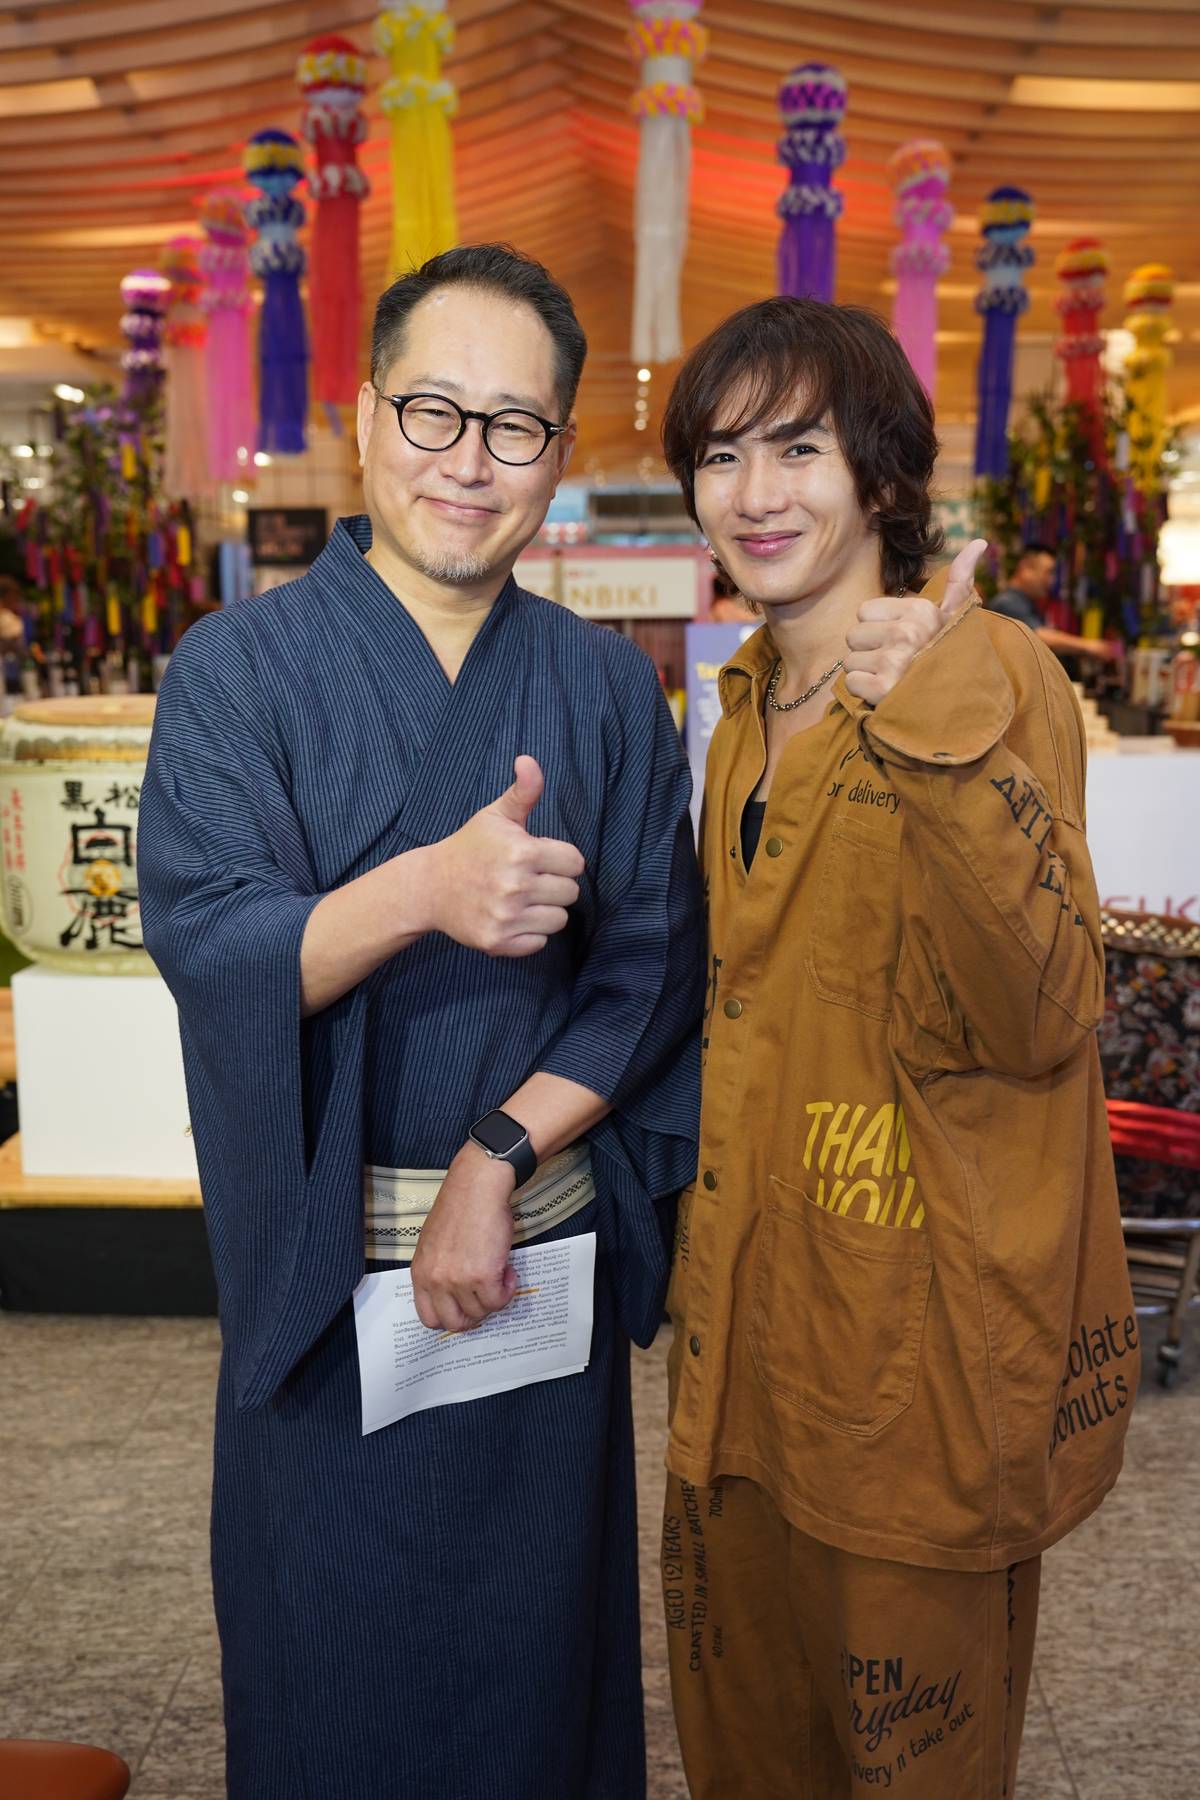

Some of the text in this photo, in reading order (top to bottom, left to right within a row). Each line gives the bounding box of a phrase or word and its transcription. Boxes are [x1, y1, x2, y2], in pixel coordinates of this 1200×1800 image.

[847, 779, 901, 815] delivery
[663, 1514, 682, 1561] YEARS
[666, 1564, 683, 1583] 12
[692, 1541, 709, 1584] SMALL
[693, 1584, 708, 1600] IN
[689, 1602, 707, 1673] CRAFTED
[840, 1652, 903, 1696] PEN
[909, 1728, 946, 1758] take
[948, 1702, 976, 1732] out
